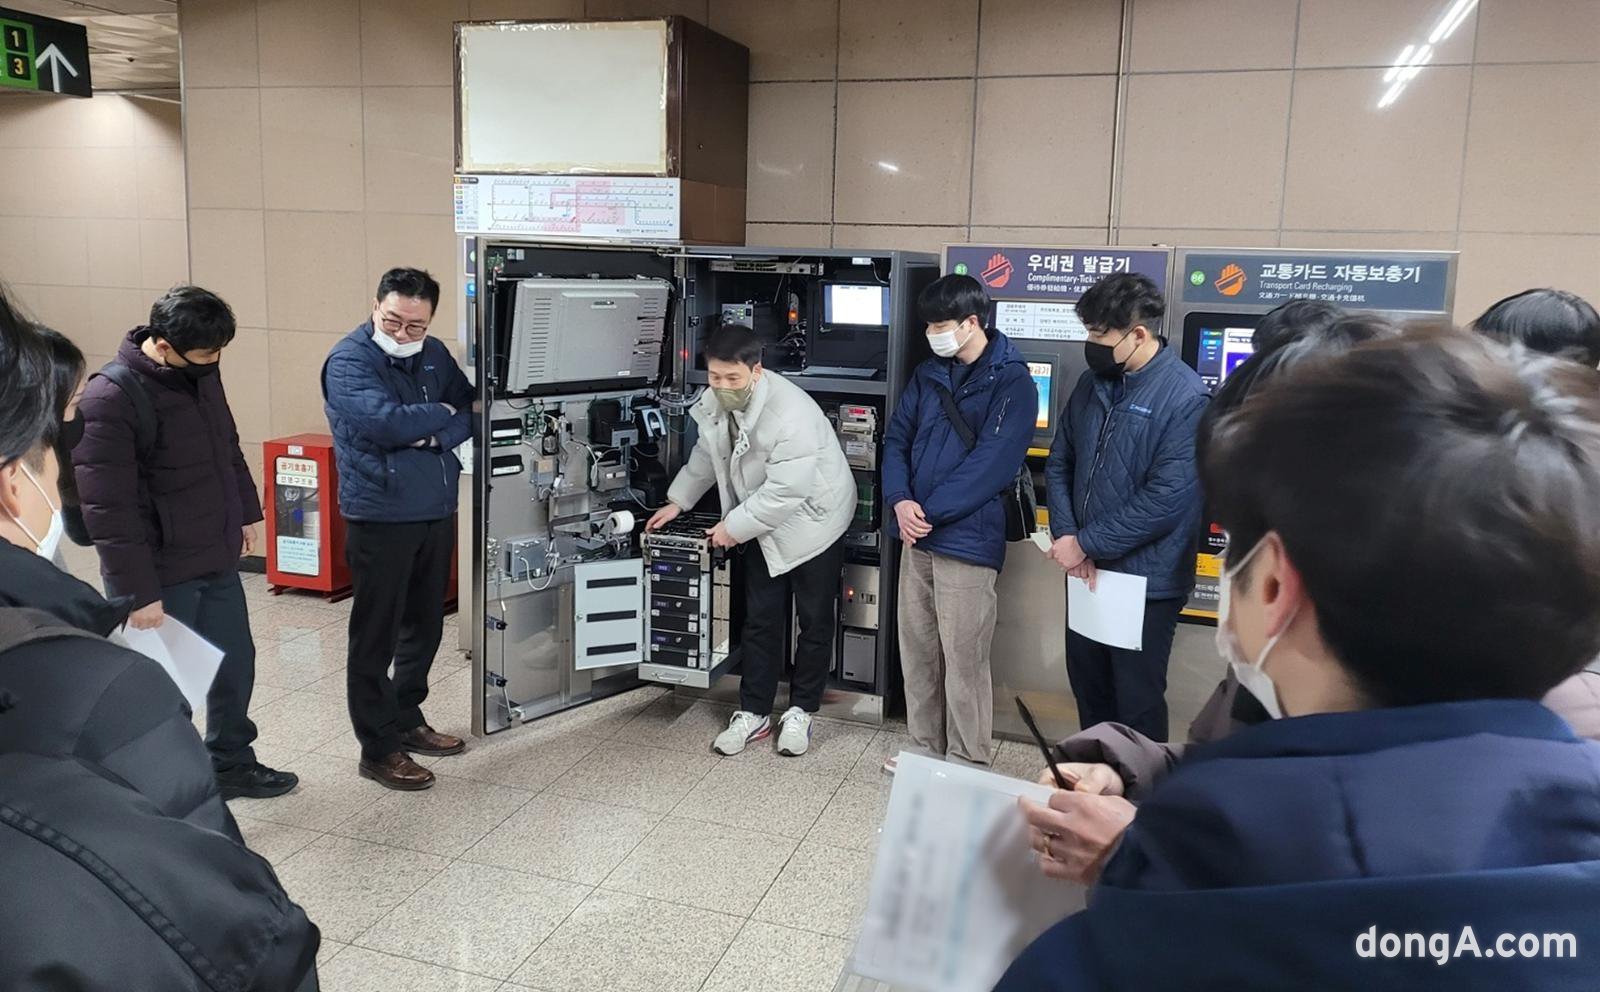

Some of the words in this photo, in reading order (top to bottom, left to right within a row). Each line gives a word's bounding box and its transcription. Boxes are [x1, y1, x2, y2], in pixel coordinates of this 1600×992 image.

[12, 31, 19, 47] 1
[14, 58, 24, 75] 3
[1027, 254, 1074, 272] 우대권
[1083, 256, 1131, 274] 발급기
[1259, 263, 1328, 279] 교통카드
[1332, 265, 1421, 283] 자동보충기
[1260, 280, 1293, 291] Transport
[1294, 281, 1312, 291] Card
[1312, 282, 1353, 293] Recharging
